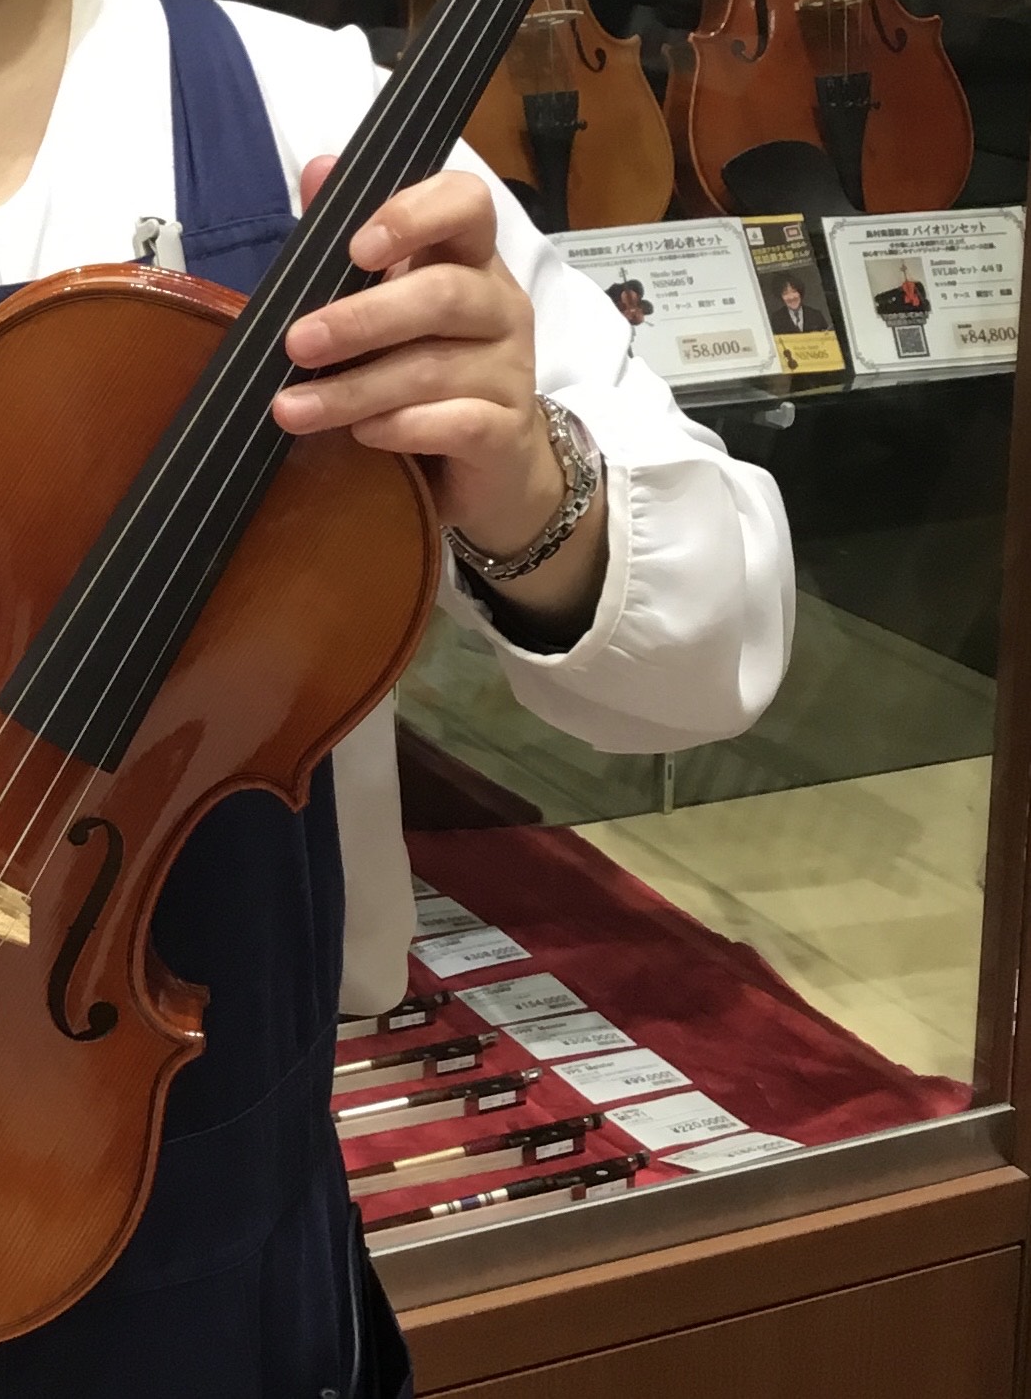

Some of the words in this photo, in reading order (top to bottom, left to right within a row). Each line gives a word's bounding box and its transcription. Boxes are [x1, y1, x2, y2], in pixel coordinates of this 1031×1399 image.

[913, 222, 987, 236] バイオリンセット
[960, 326, 1017, 344] ¥84,800
[683, 340, 740, 360] ¥58,000
